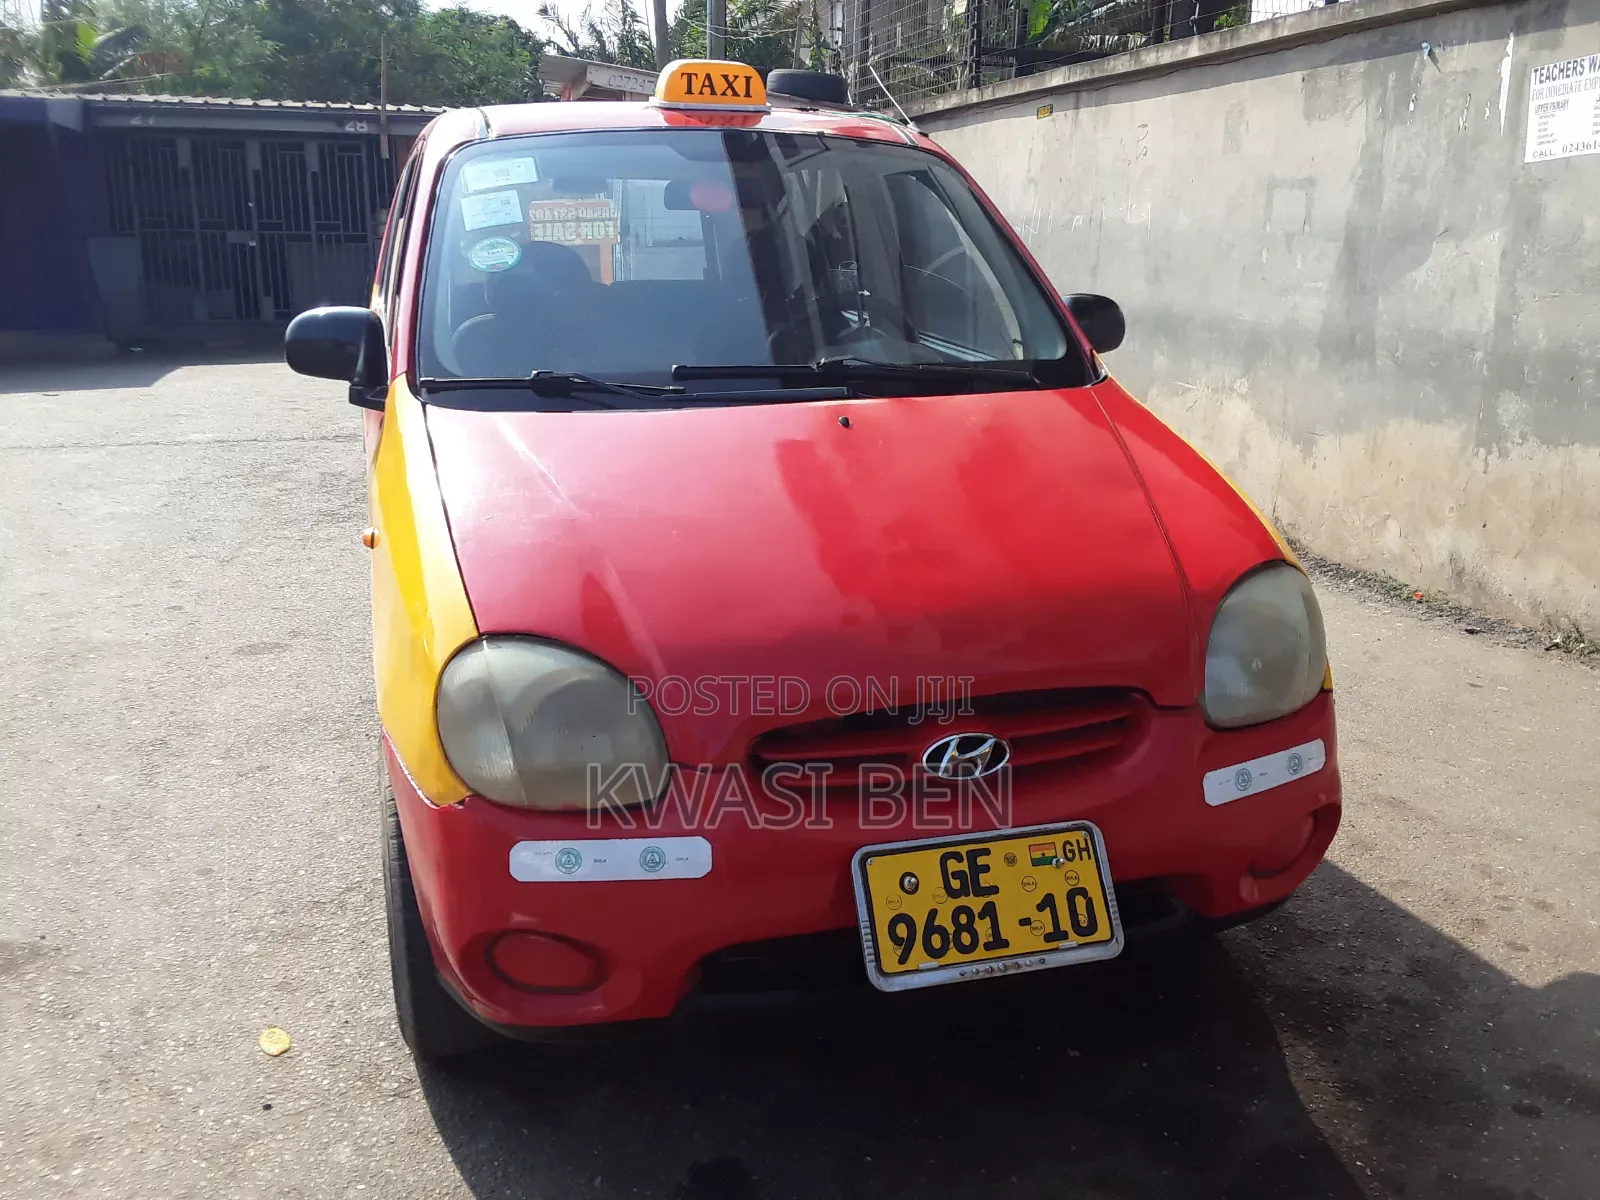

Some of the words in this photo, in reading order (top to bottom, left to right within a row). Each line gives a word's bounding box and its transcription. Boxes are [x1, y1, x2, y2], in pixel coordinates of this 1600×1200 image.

[1533, 58, 1585, 85] TEACHERS
[681, 72, 753, 98] TAXI
[1532, 87, 1545, 102] FOR
[1535, 103, 1549, 114] UPPER
[1549, 99, 1569, 112] PRIMARY
[939, 847, 1000, 900] GE
[1061, 838, 1092, 863] GH
